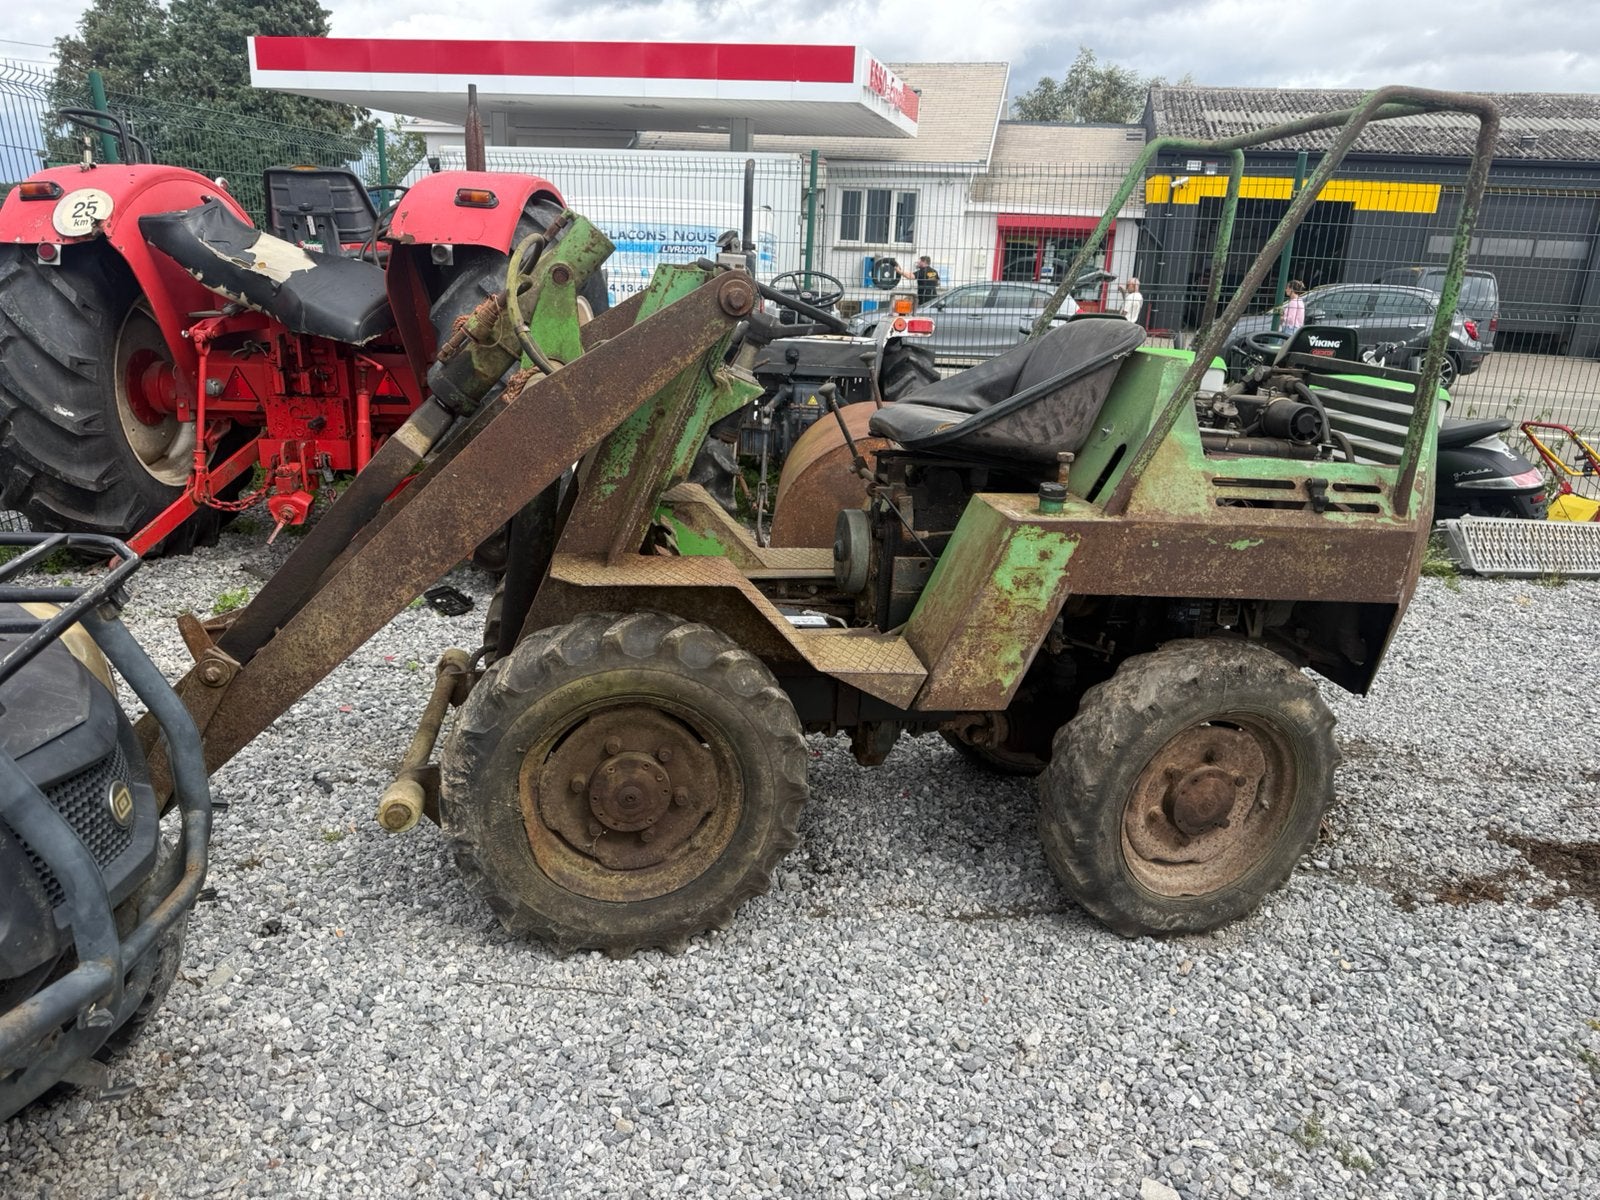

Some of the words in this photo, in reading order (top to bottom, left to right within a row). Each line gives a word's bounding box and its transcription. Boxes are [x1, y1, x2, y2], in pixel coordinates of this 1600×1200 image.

[71, 200, 99, 218] 25
[73, 218, 89, 227] km
[661, 245, 706, 254] LIVRAISON
[1309, 337, 1342, 349] VIKING
